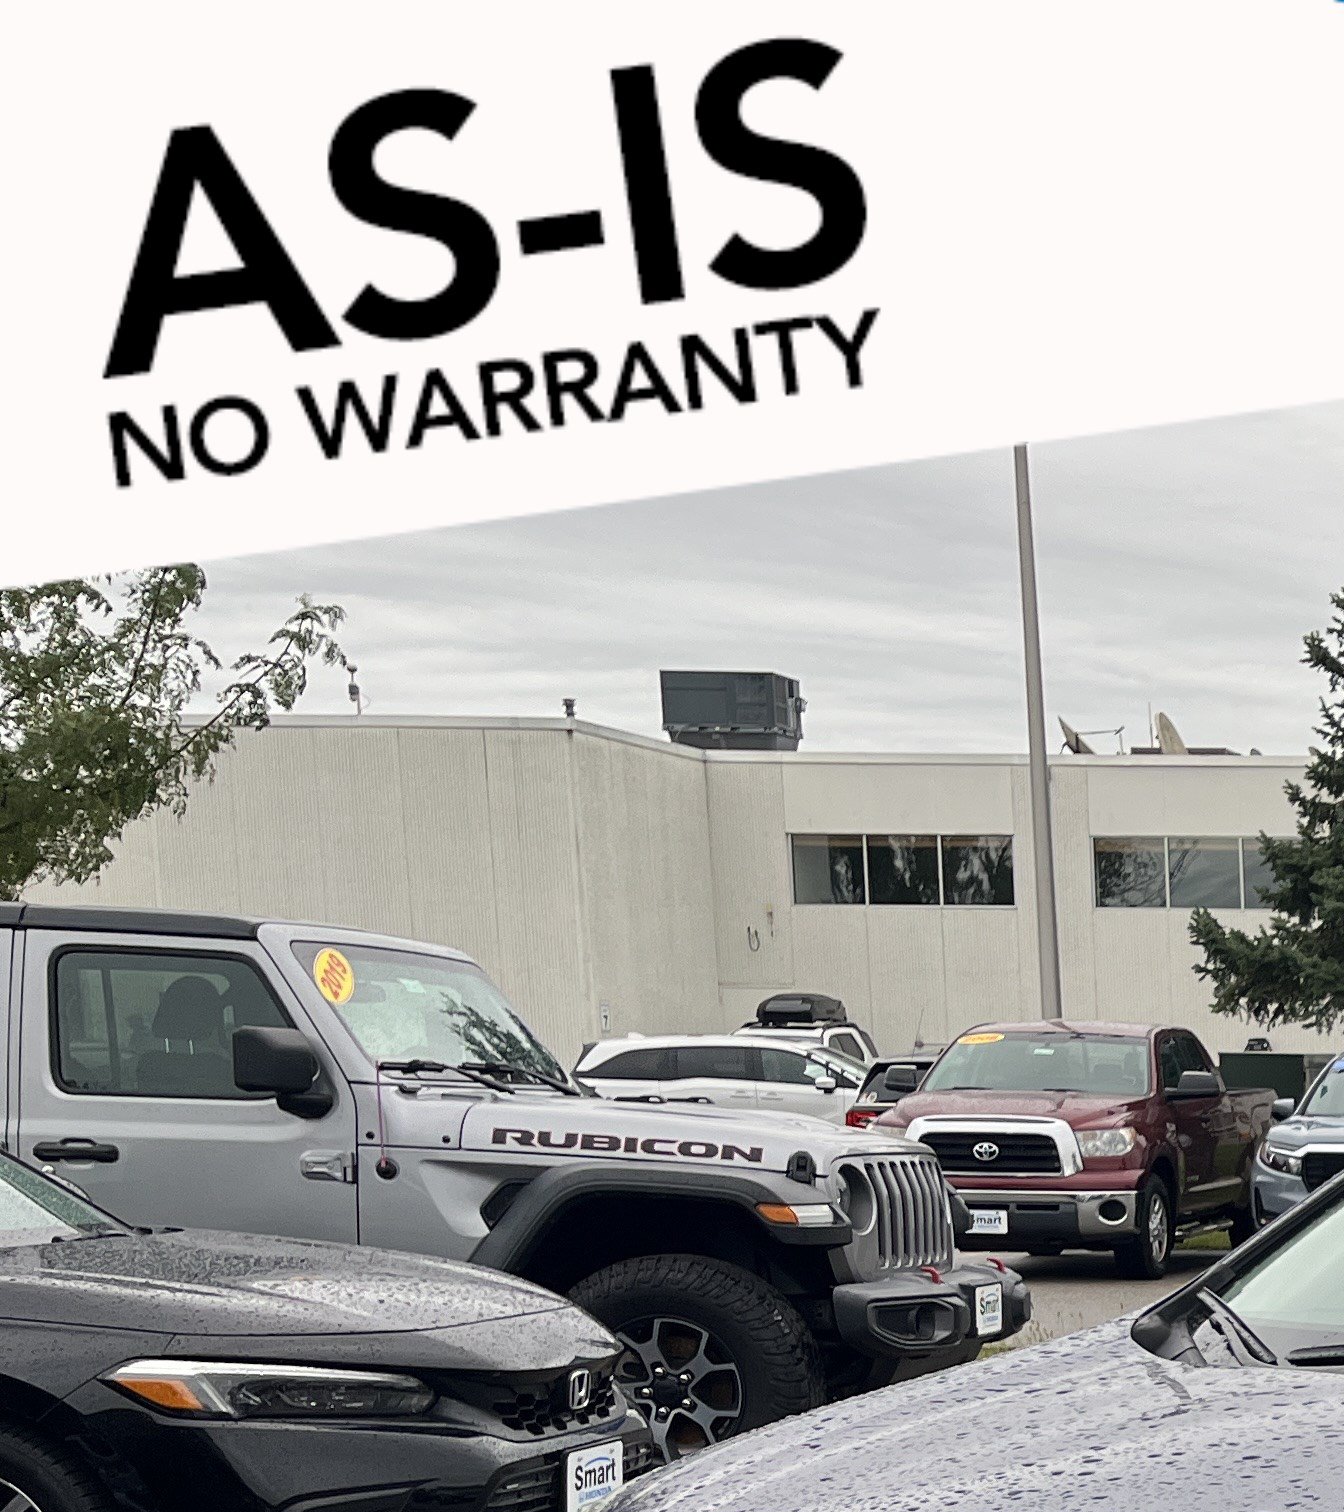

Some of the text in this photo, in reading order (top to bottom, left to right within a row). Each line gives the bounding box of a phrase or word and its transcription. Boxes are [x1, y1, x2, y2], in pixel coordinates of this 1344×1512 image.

[321, 953, 347, 1000] 2019
[492, 1127, 764, 1163] RUBICON
[972, 1213, 1002, 1225] mart
[574, 1458, 616, 1491] Smart
